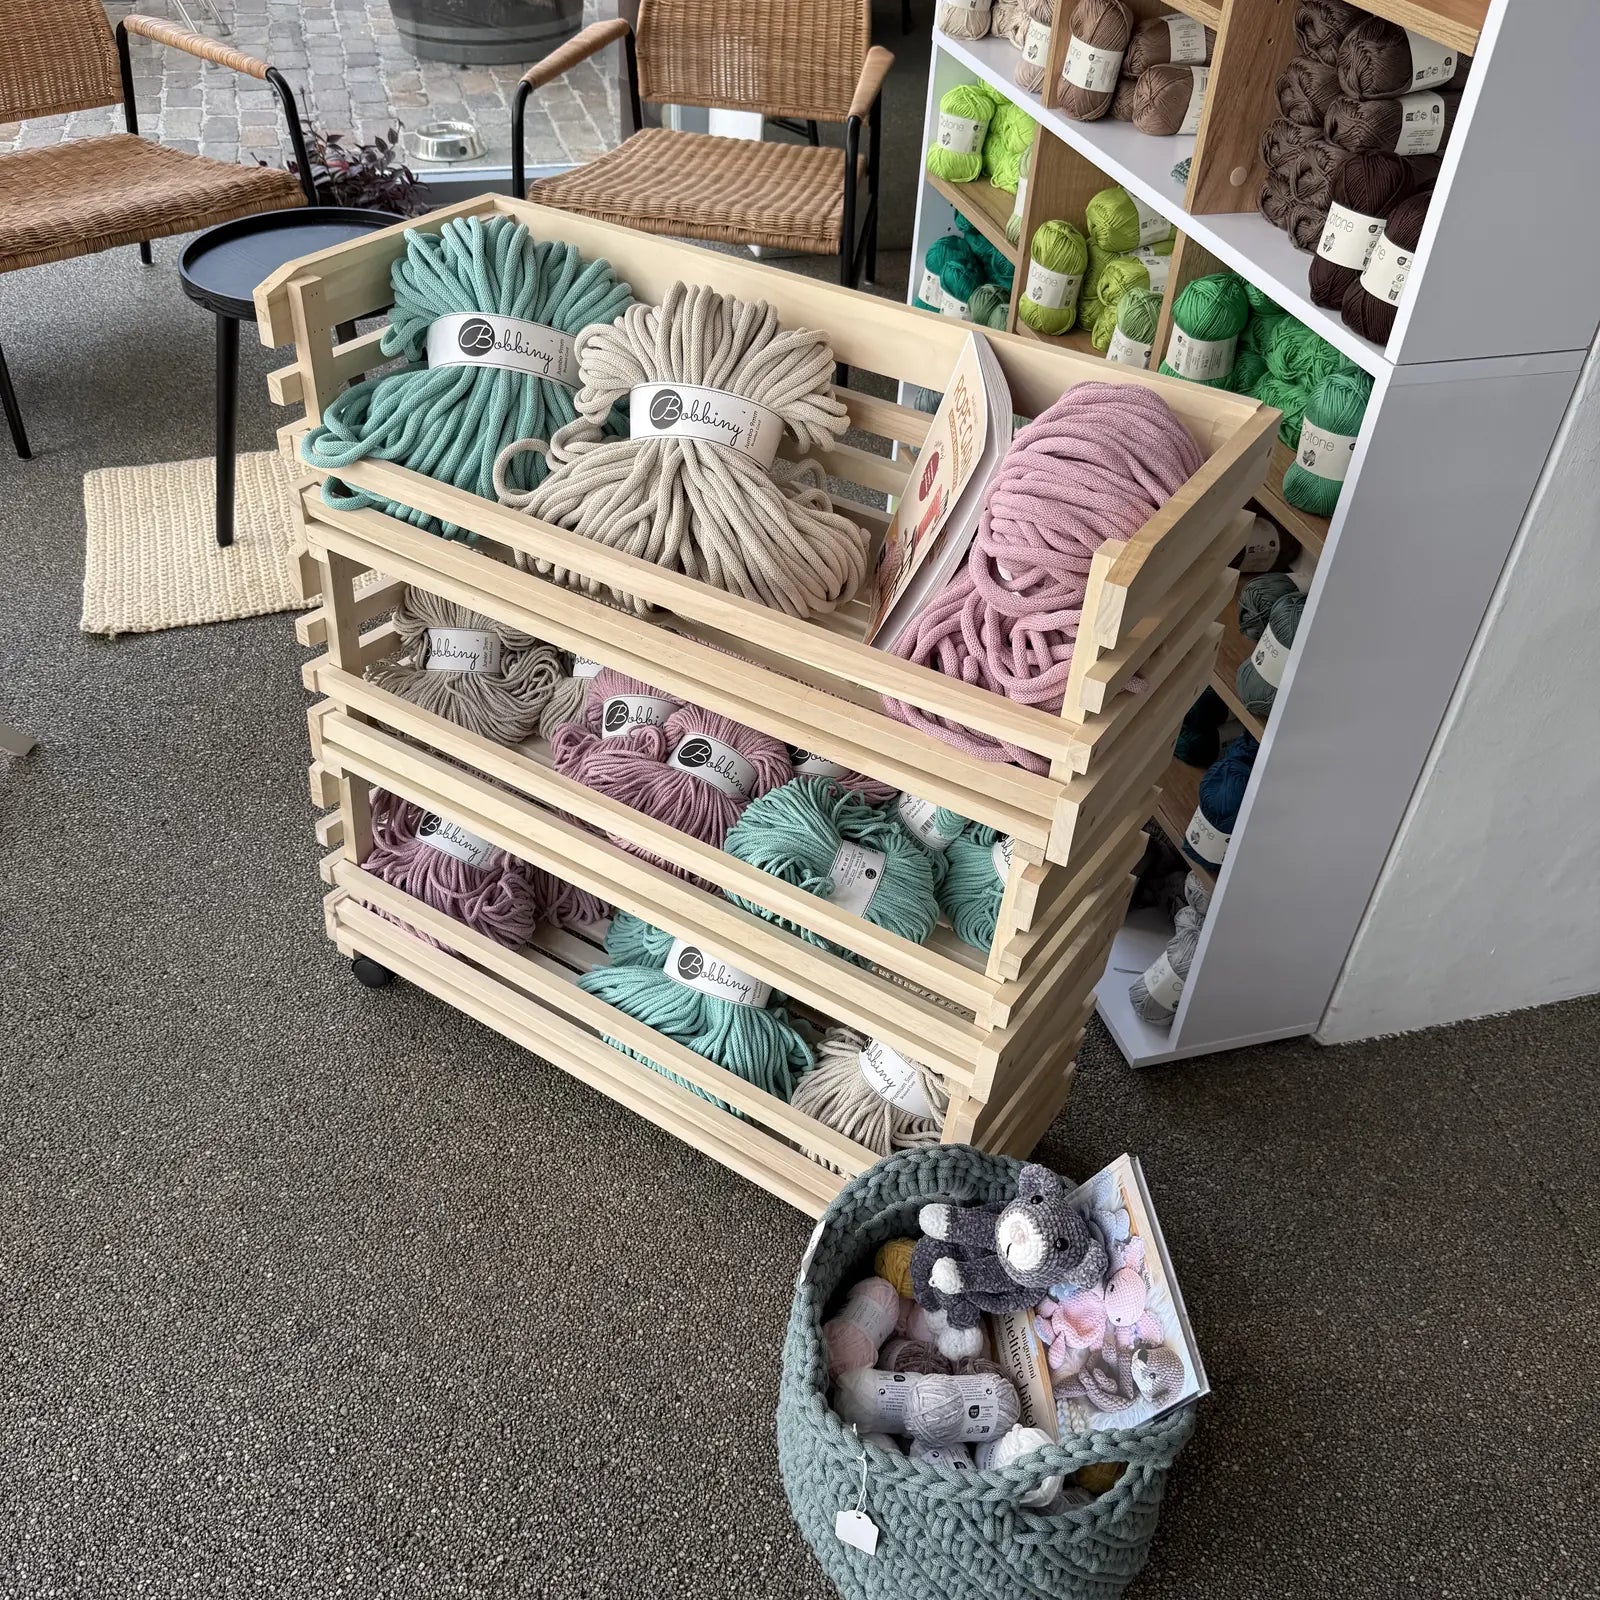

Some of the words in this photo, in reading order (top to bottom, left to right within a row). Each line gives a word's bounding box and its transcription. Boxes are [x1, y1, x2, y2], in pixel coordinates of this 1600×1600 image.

[1329, 210, 1354, 233] otone
[459, 323, 554, 374] Bobbiny
[649, 395, 743, 446] Bobbiny
[605, 704, 665, 729] Bobbi
[420, 813, 481, 862] Bobbiny
[679, 952, 752, 1002] Bobbiny
[1003, 1312, 1026, 1380] cheltiere
[1018, 1383, 1038, 1428] häkel
[1020, 1326, 1038, 1379] Amigurumi
